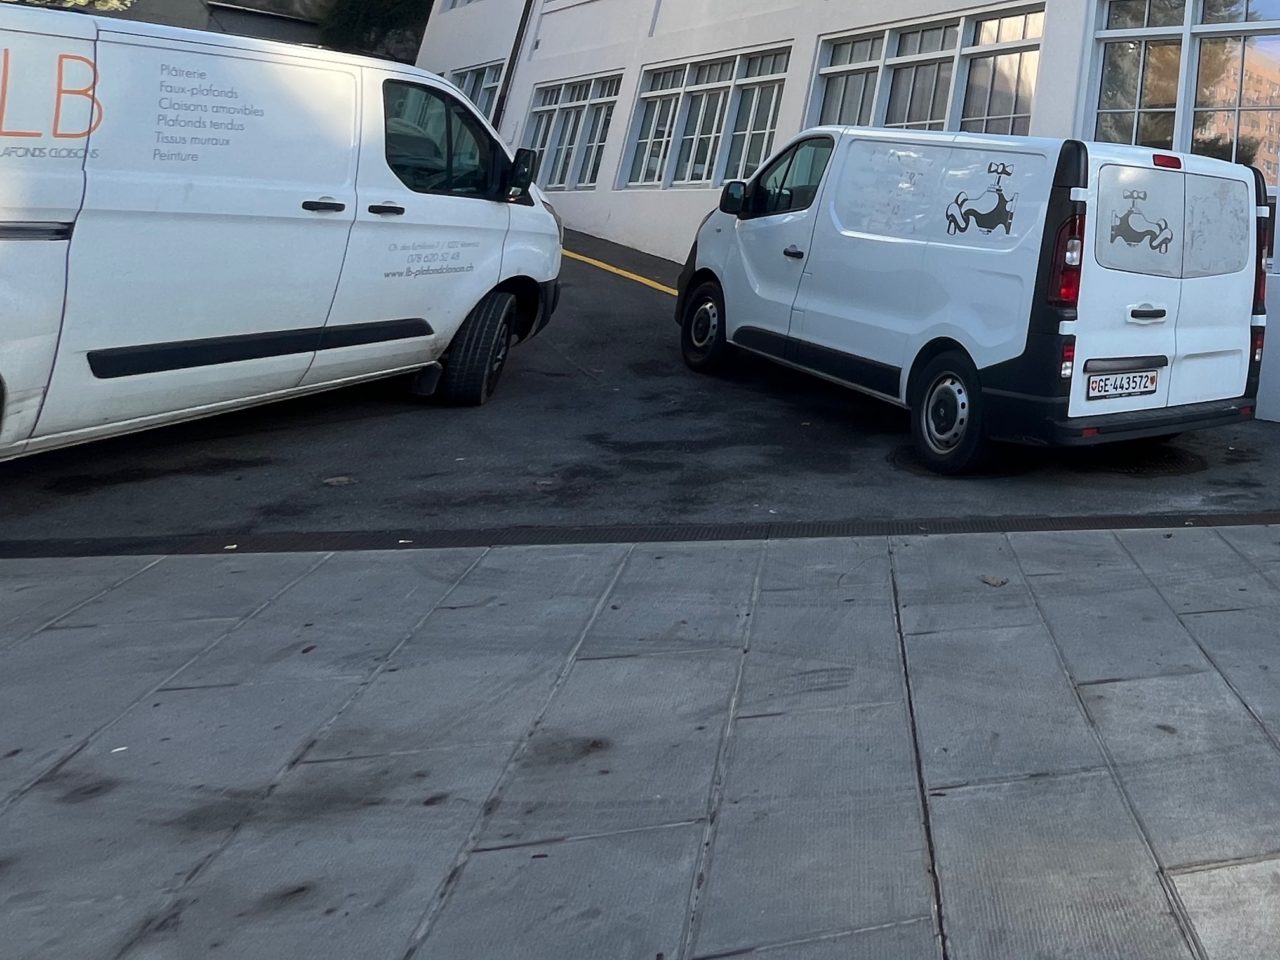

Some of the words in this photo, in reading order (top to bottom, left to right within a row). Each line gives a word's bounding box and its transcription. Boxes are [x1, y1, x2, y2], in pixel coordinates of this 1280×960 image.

[160, 63, 207, 80] Plâtrerie
[159, 80, 239, 99] Faux-plafonds
[158, 97, 208, 113] Cloisons
[211, 104, 264, 117] amovibles
[157, 113, 207, 129] Plafonds
[209, 119, 245, 131] tendus
[154, 131, 187, 145] Tissus
[190, 136, 230, 146] muraux
[0, 146, 47, 158] AFONDS
[152, 148, 199, 162] Peinture
